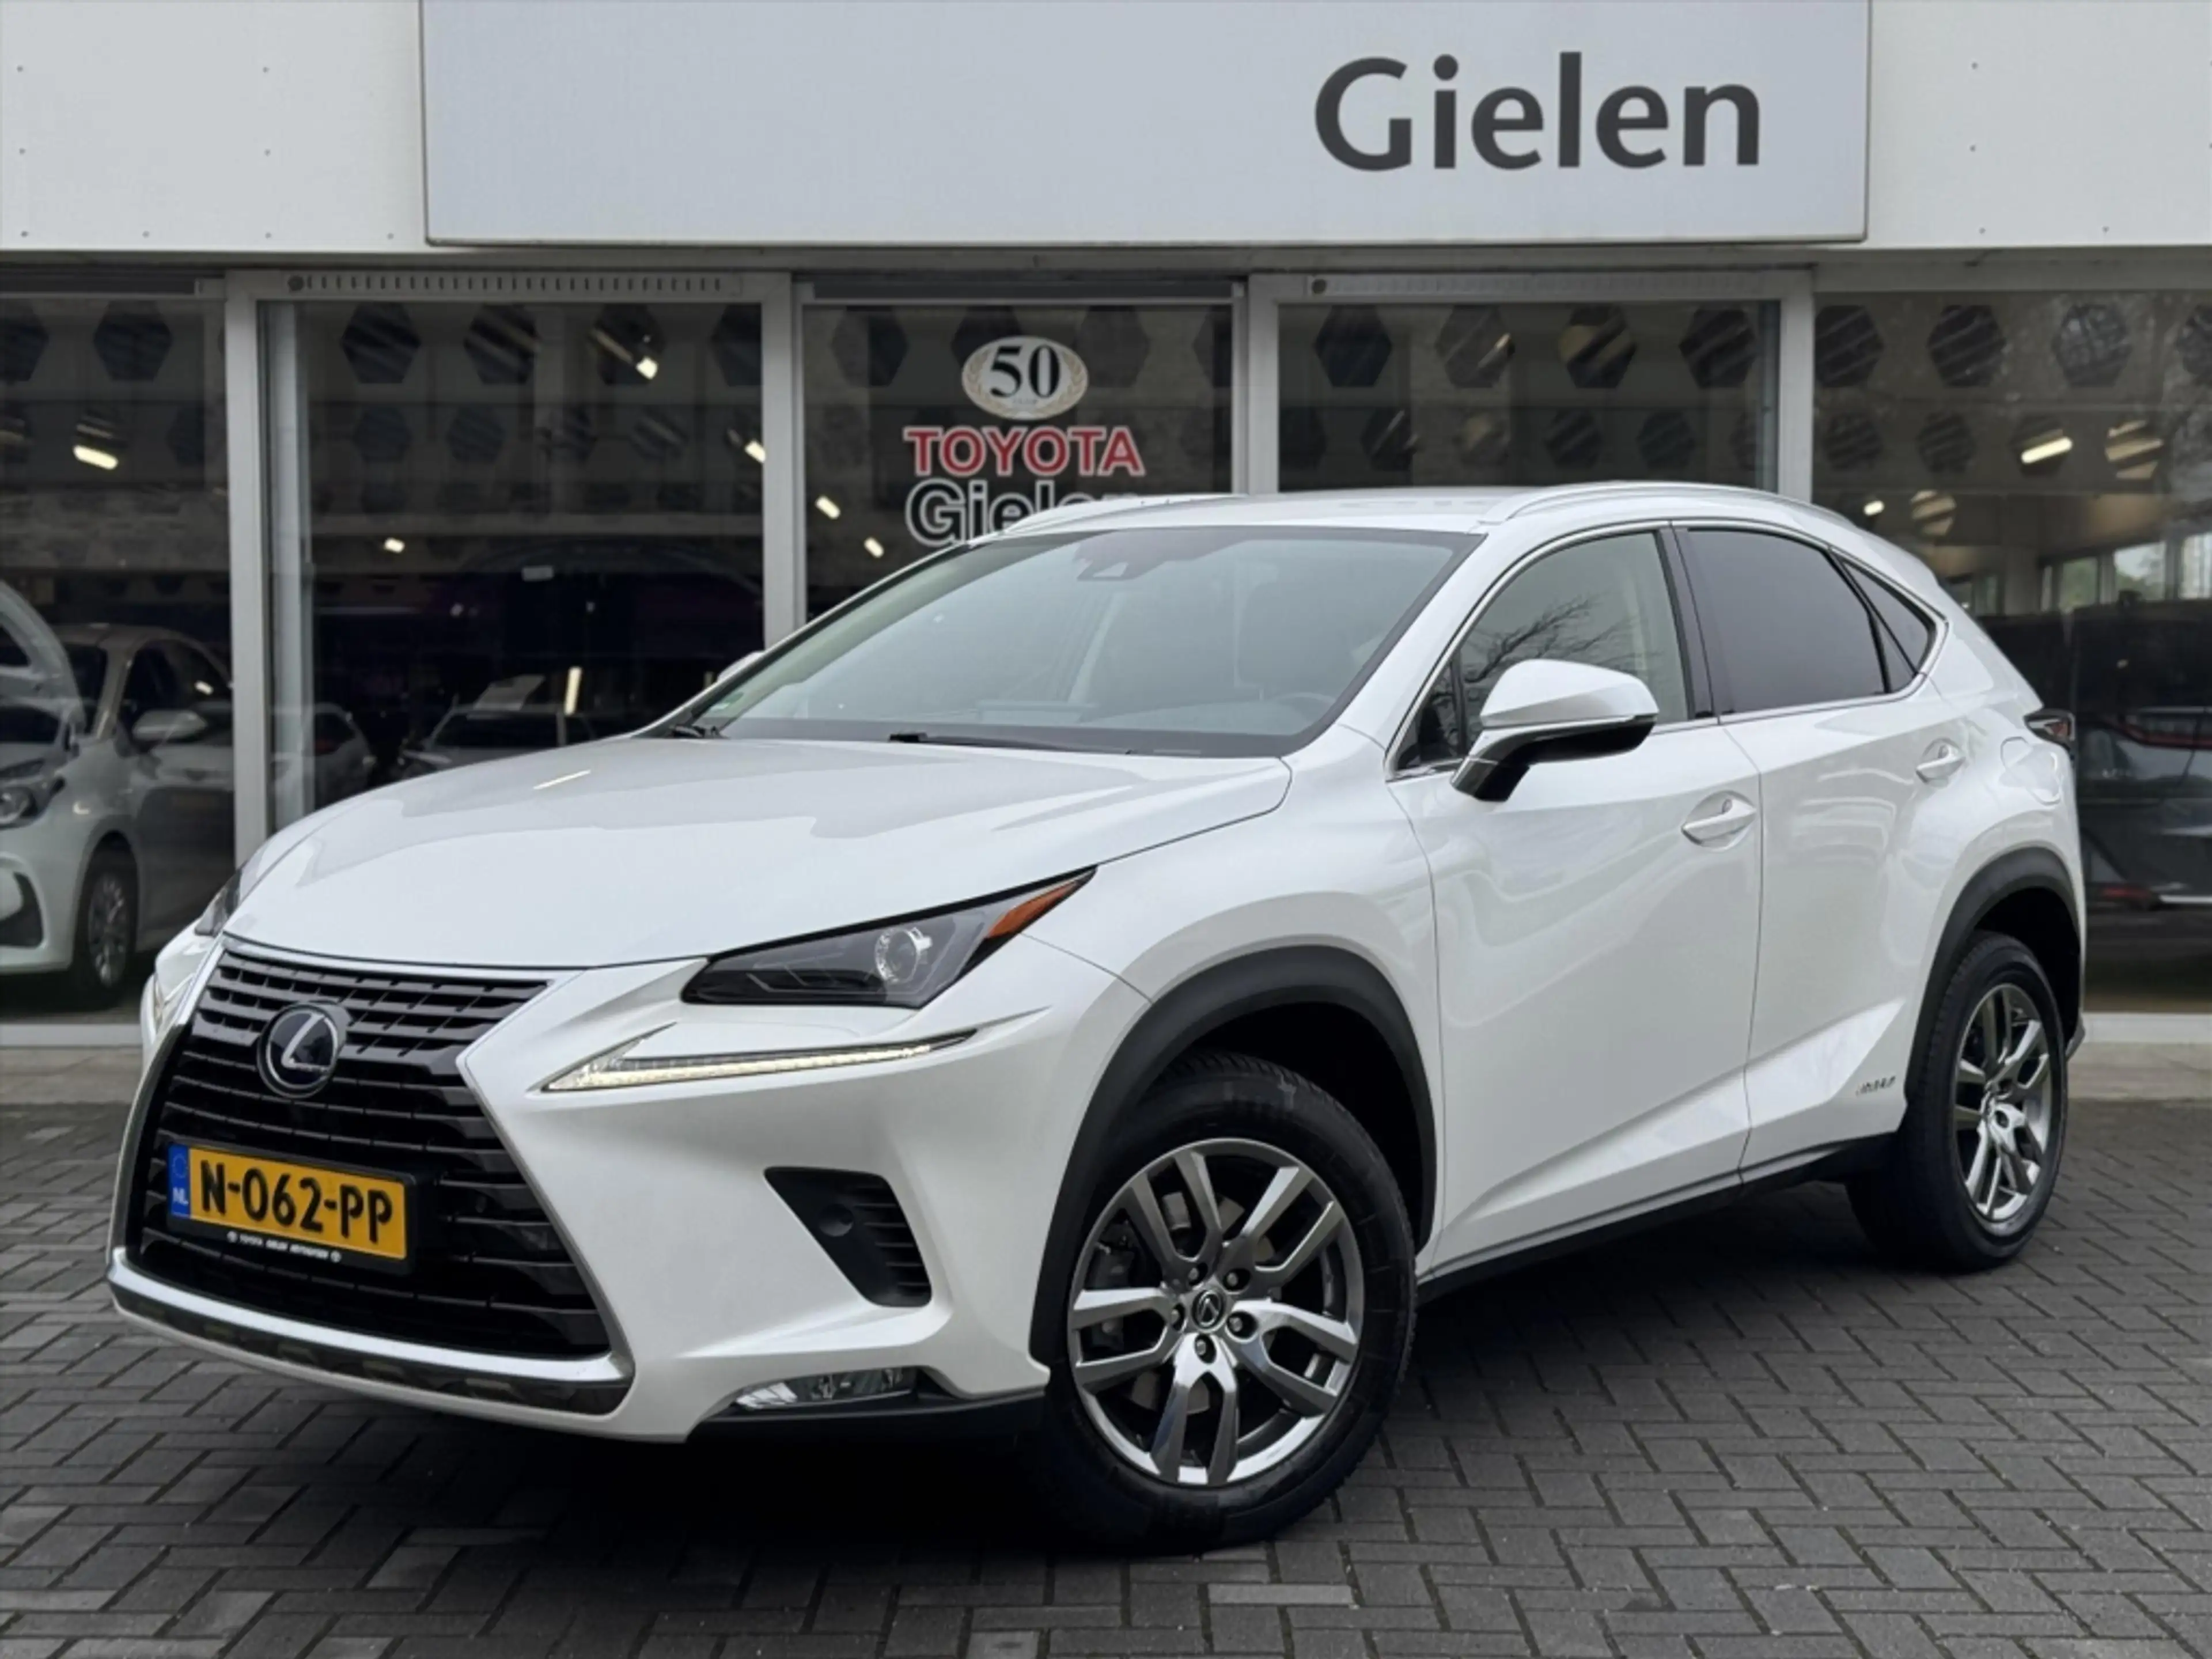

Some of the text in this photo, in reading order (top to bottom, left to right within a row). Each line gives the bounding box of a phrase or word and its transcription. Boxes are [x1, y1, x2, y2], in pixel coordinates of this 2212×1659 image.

[1315, 51, 1760, 172] Gielen
[990, 345, 1060, 399] 50
[903, 426, 1146, 477] TOYOTA
[906, 478, 1139, 548] Giel
[173, 1187, 189, 1206] NL
[200, 1160, 393, 1244] N-062-PP
